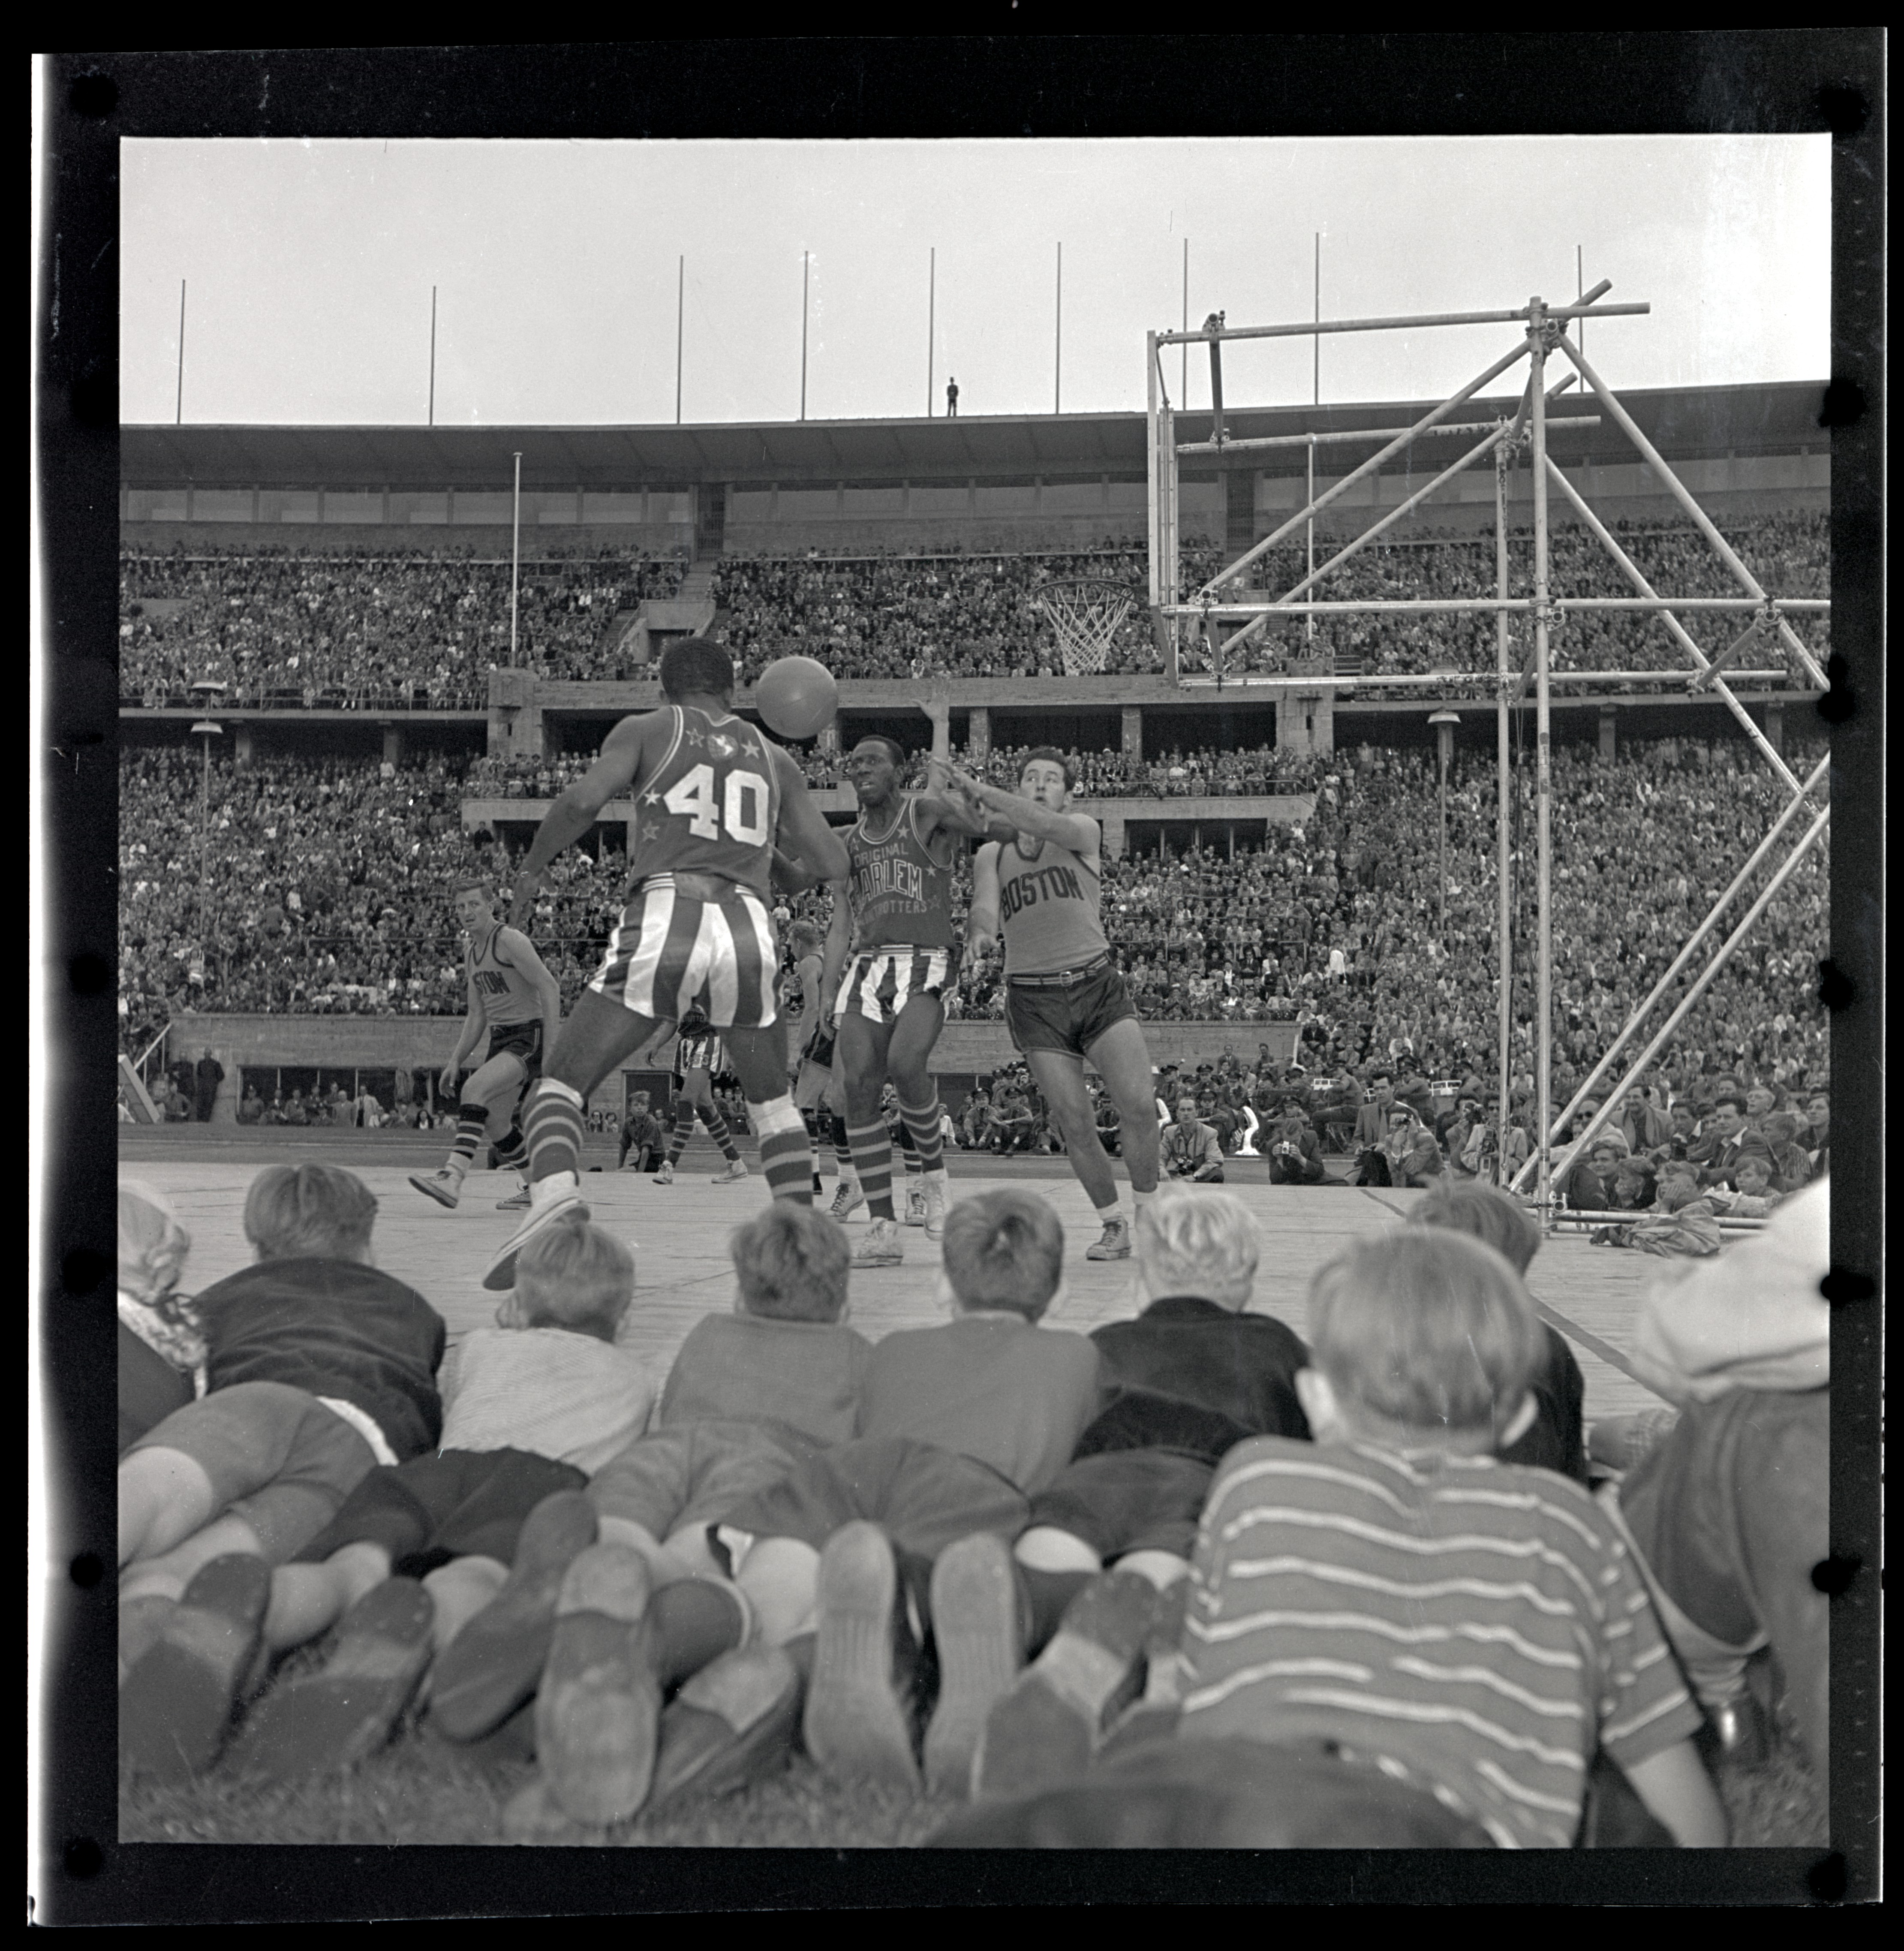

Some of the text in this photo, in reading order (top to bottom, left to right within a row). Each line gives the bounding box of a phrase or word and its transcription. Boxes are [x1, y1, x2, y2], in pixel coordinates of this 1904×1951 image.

[663, 763, 769, 847] 40
[854, 843, 908, 867] ORIGINAL
[1000, 866, 1084, 922] BOSTON
[472, 971, 511, 994] STON
